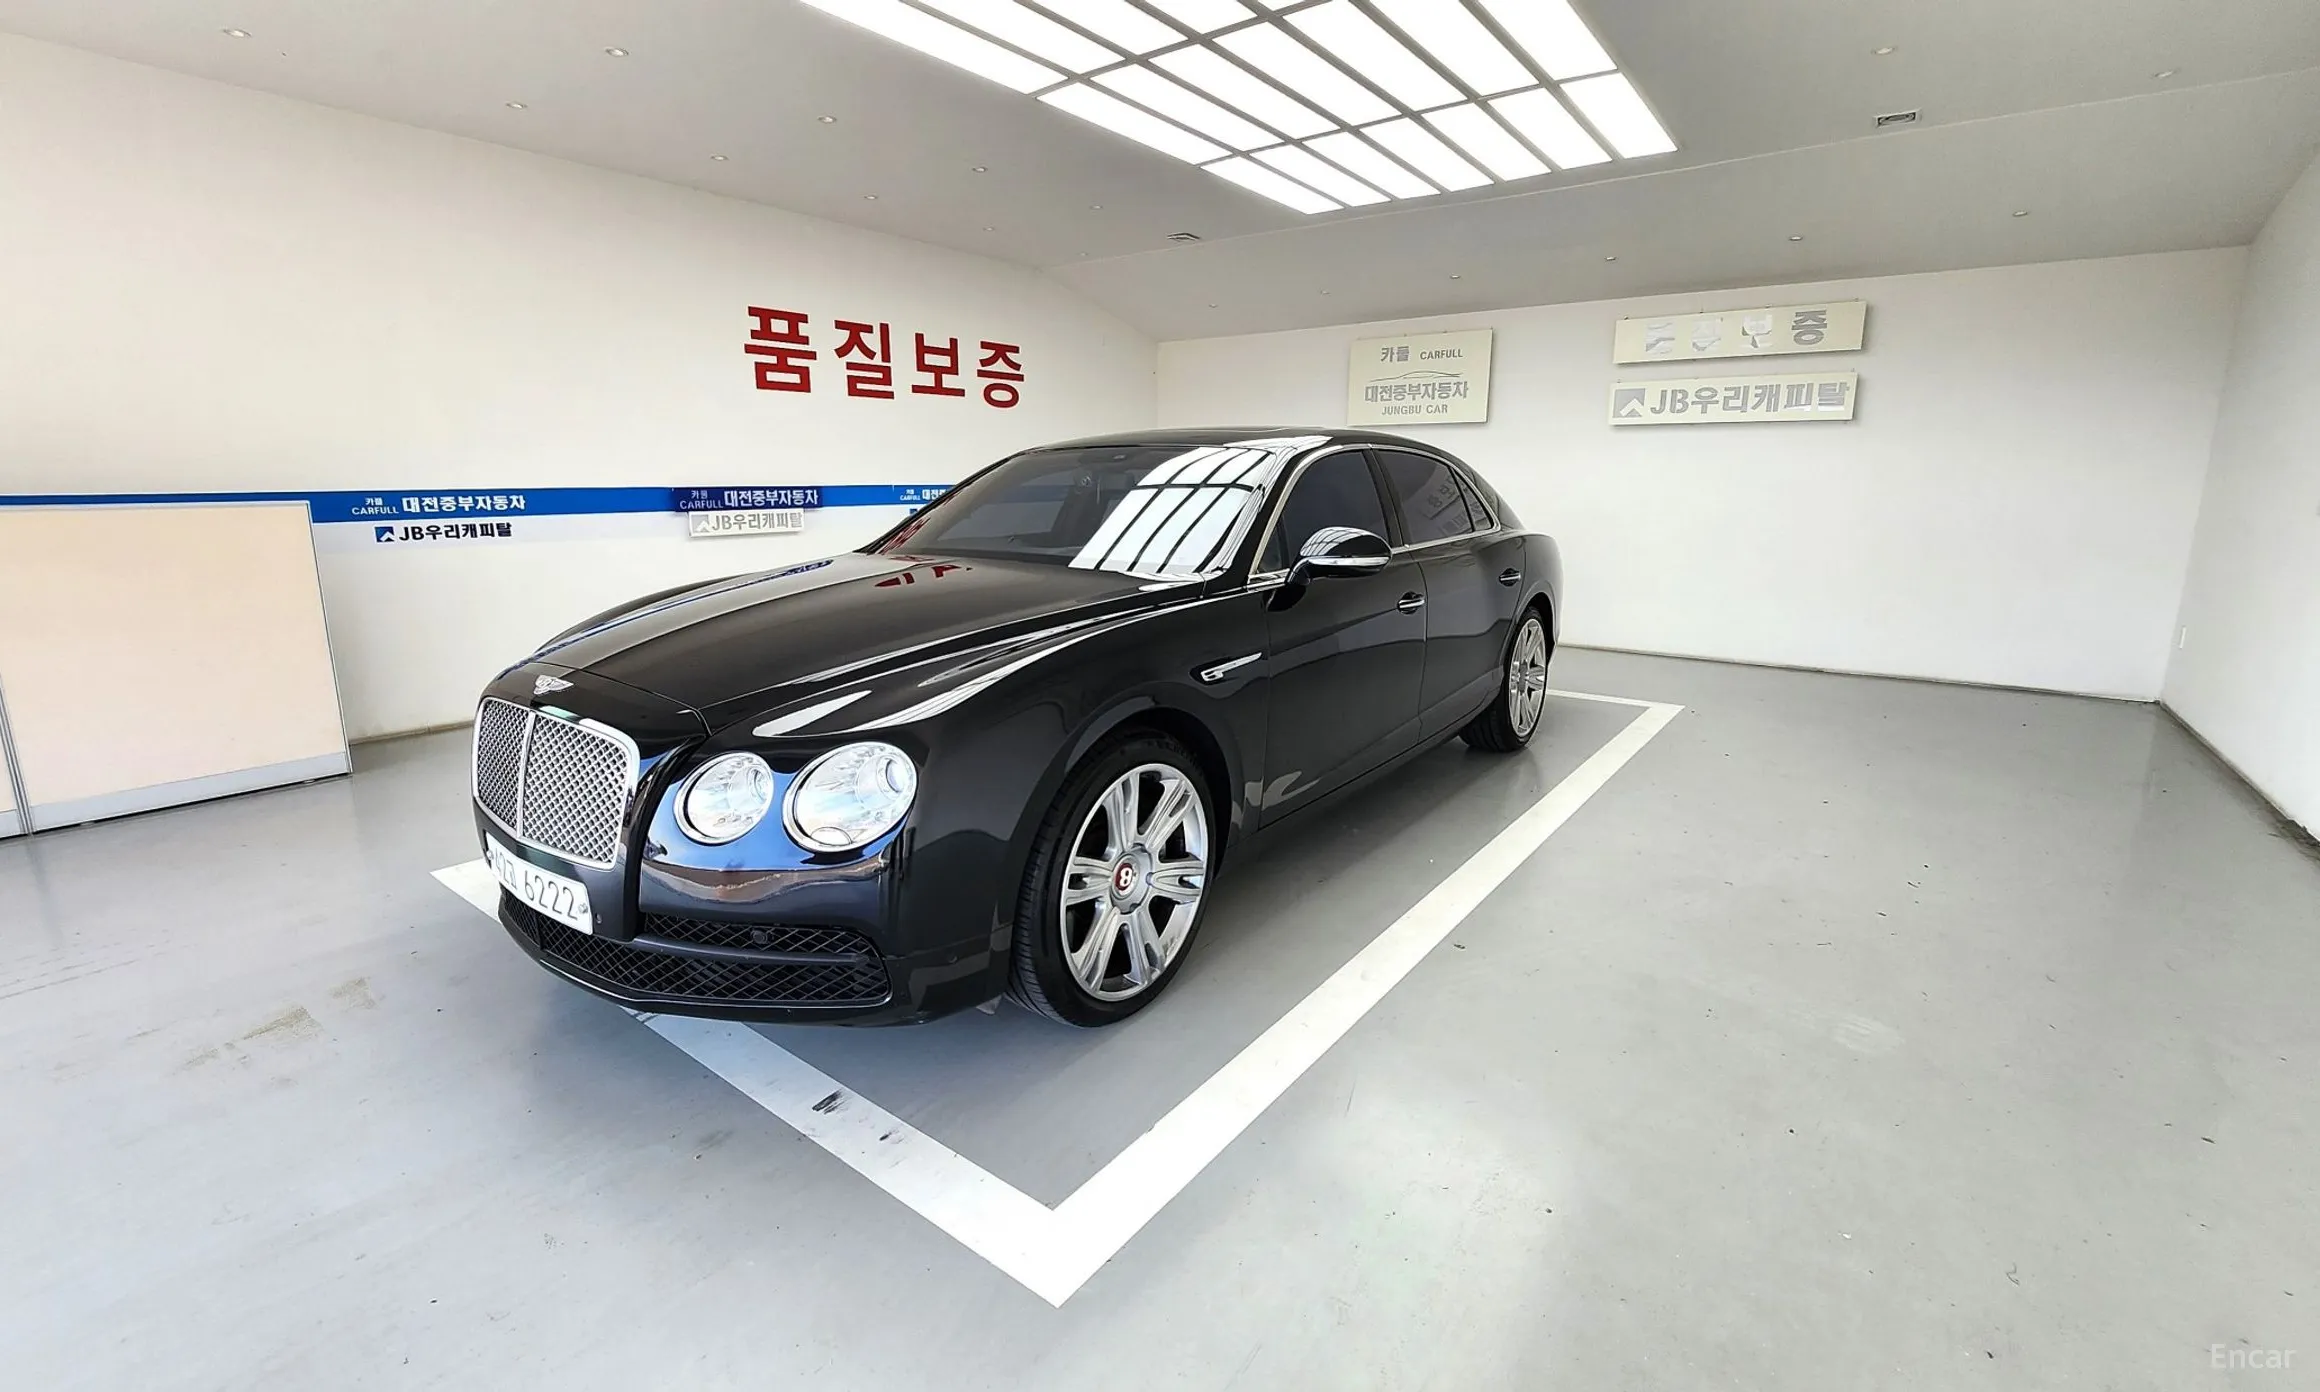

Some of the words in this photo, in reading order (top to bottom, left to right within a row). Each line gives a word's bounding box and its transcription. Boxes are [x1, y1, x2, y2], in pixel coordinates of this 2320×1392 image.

[744, 305, 1025, 408] 품질보증
[1420, 349, 1463, 360] CARFULL
[1364, 381, 1469, 402] 대전중부자동차
[1650, 382, 1850, 415] JB우리캐피탈
[1381, 405, 1422, 415] JUNGBU
[1426, 404, 1448, 414] CAR
[402, 495, 526, 513] 대전중부자동차
[680, 499, 723, 509] CARFULL
[724, 489, 818, 507] 대전중부자동차
[351, 506, 399, 515] CARFULL
[712, 512, 803, 532] JB우리캐피탈
[399, 522, 512, 541] JB우리캐피탈
[525, 870, 578, 920] 6222
